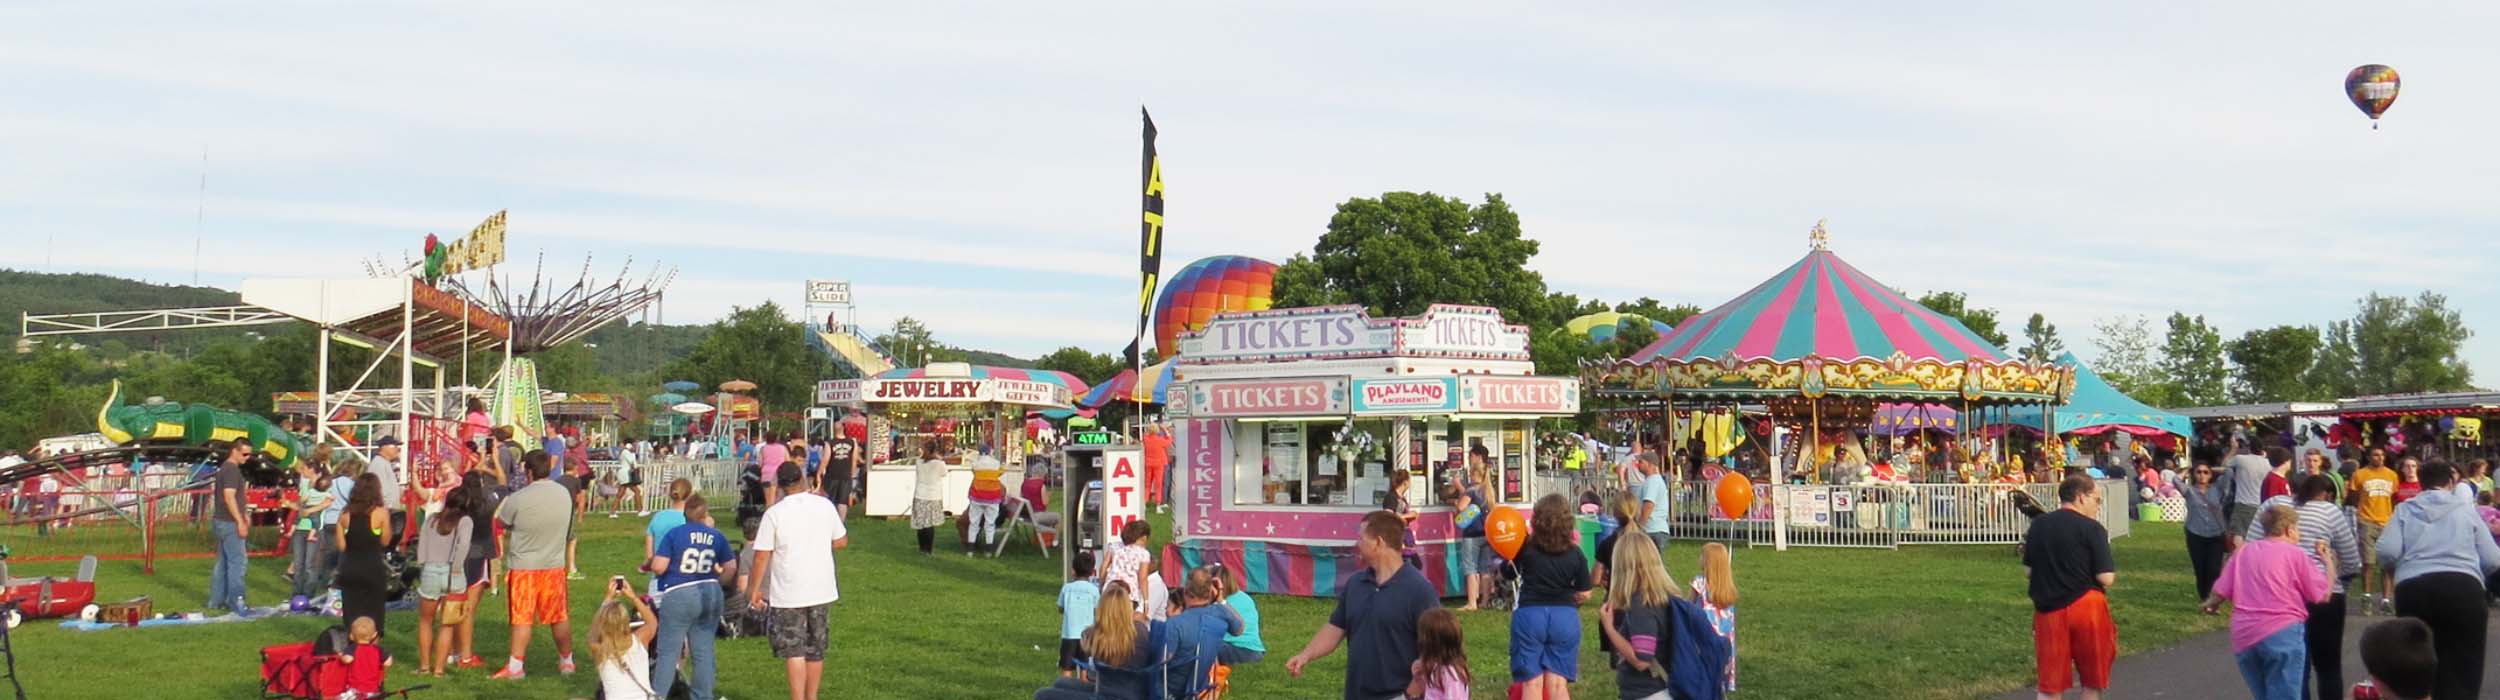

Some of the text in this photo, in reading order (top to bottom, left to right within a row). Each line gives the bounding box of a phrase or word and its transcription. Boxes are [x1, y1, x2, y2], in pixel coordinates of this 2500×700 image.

[810, 281, 848, 291] SUPER
[811, 292, 848, 301] SLIDE
[1216, 317, 1355, 350] TICKETS
[1433, 317, 1497, 347] TICKETS
[821, 381, 859, 391] JEWELRY
[875, 381, 981, 398] JEWELRY
[999, 381, 1048, 392] JEWELRY
[1367, 383, 1443, 402] PLAYLAND
[1481, 383, 1559, 404] TICKETS
[826, 391, 853, 401] GIFTS
[1006, 391, 1041, 401] GIFTS
[1218, 386, 1318, 409] TICKETS
[1078, 433, 1108, 444] ATM
[1194, 418, 1215, 534] TICKETS
[1112, 457, 1137, 536] ATM
[690, 531, 715, 546] PUIG
[680, 547, 716, 574] 66
